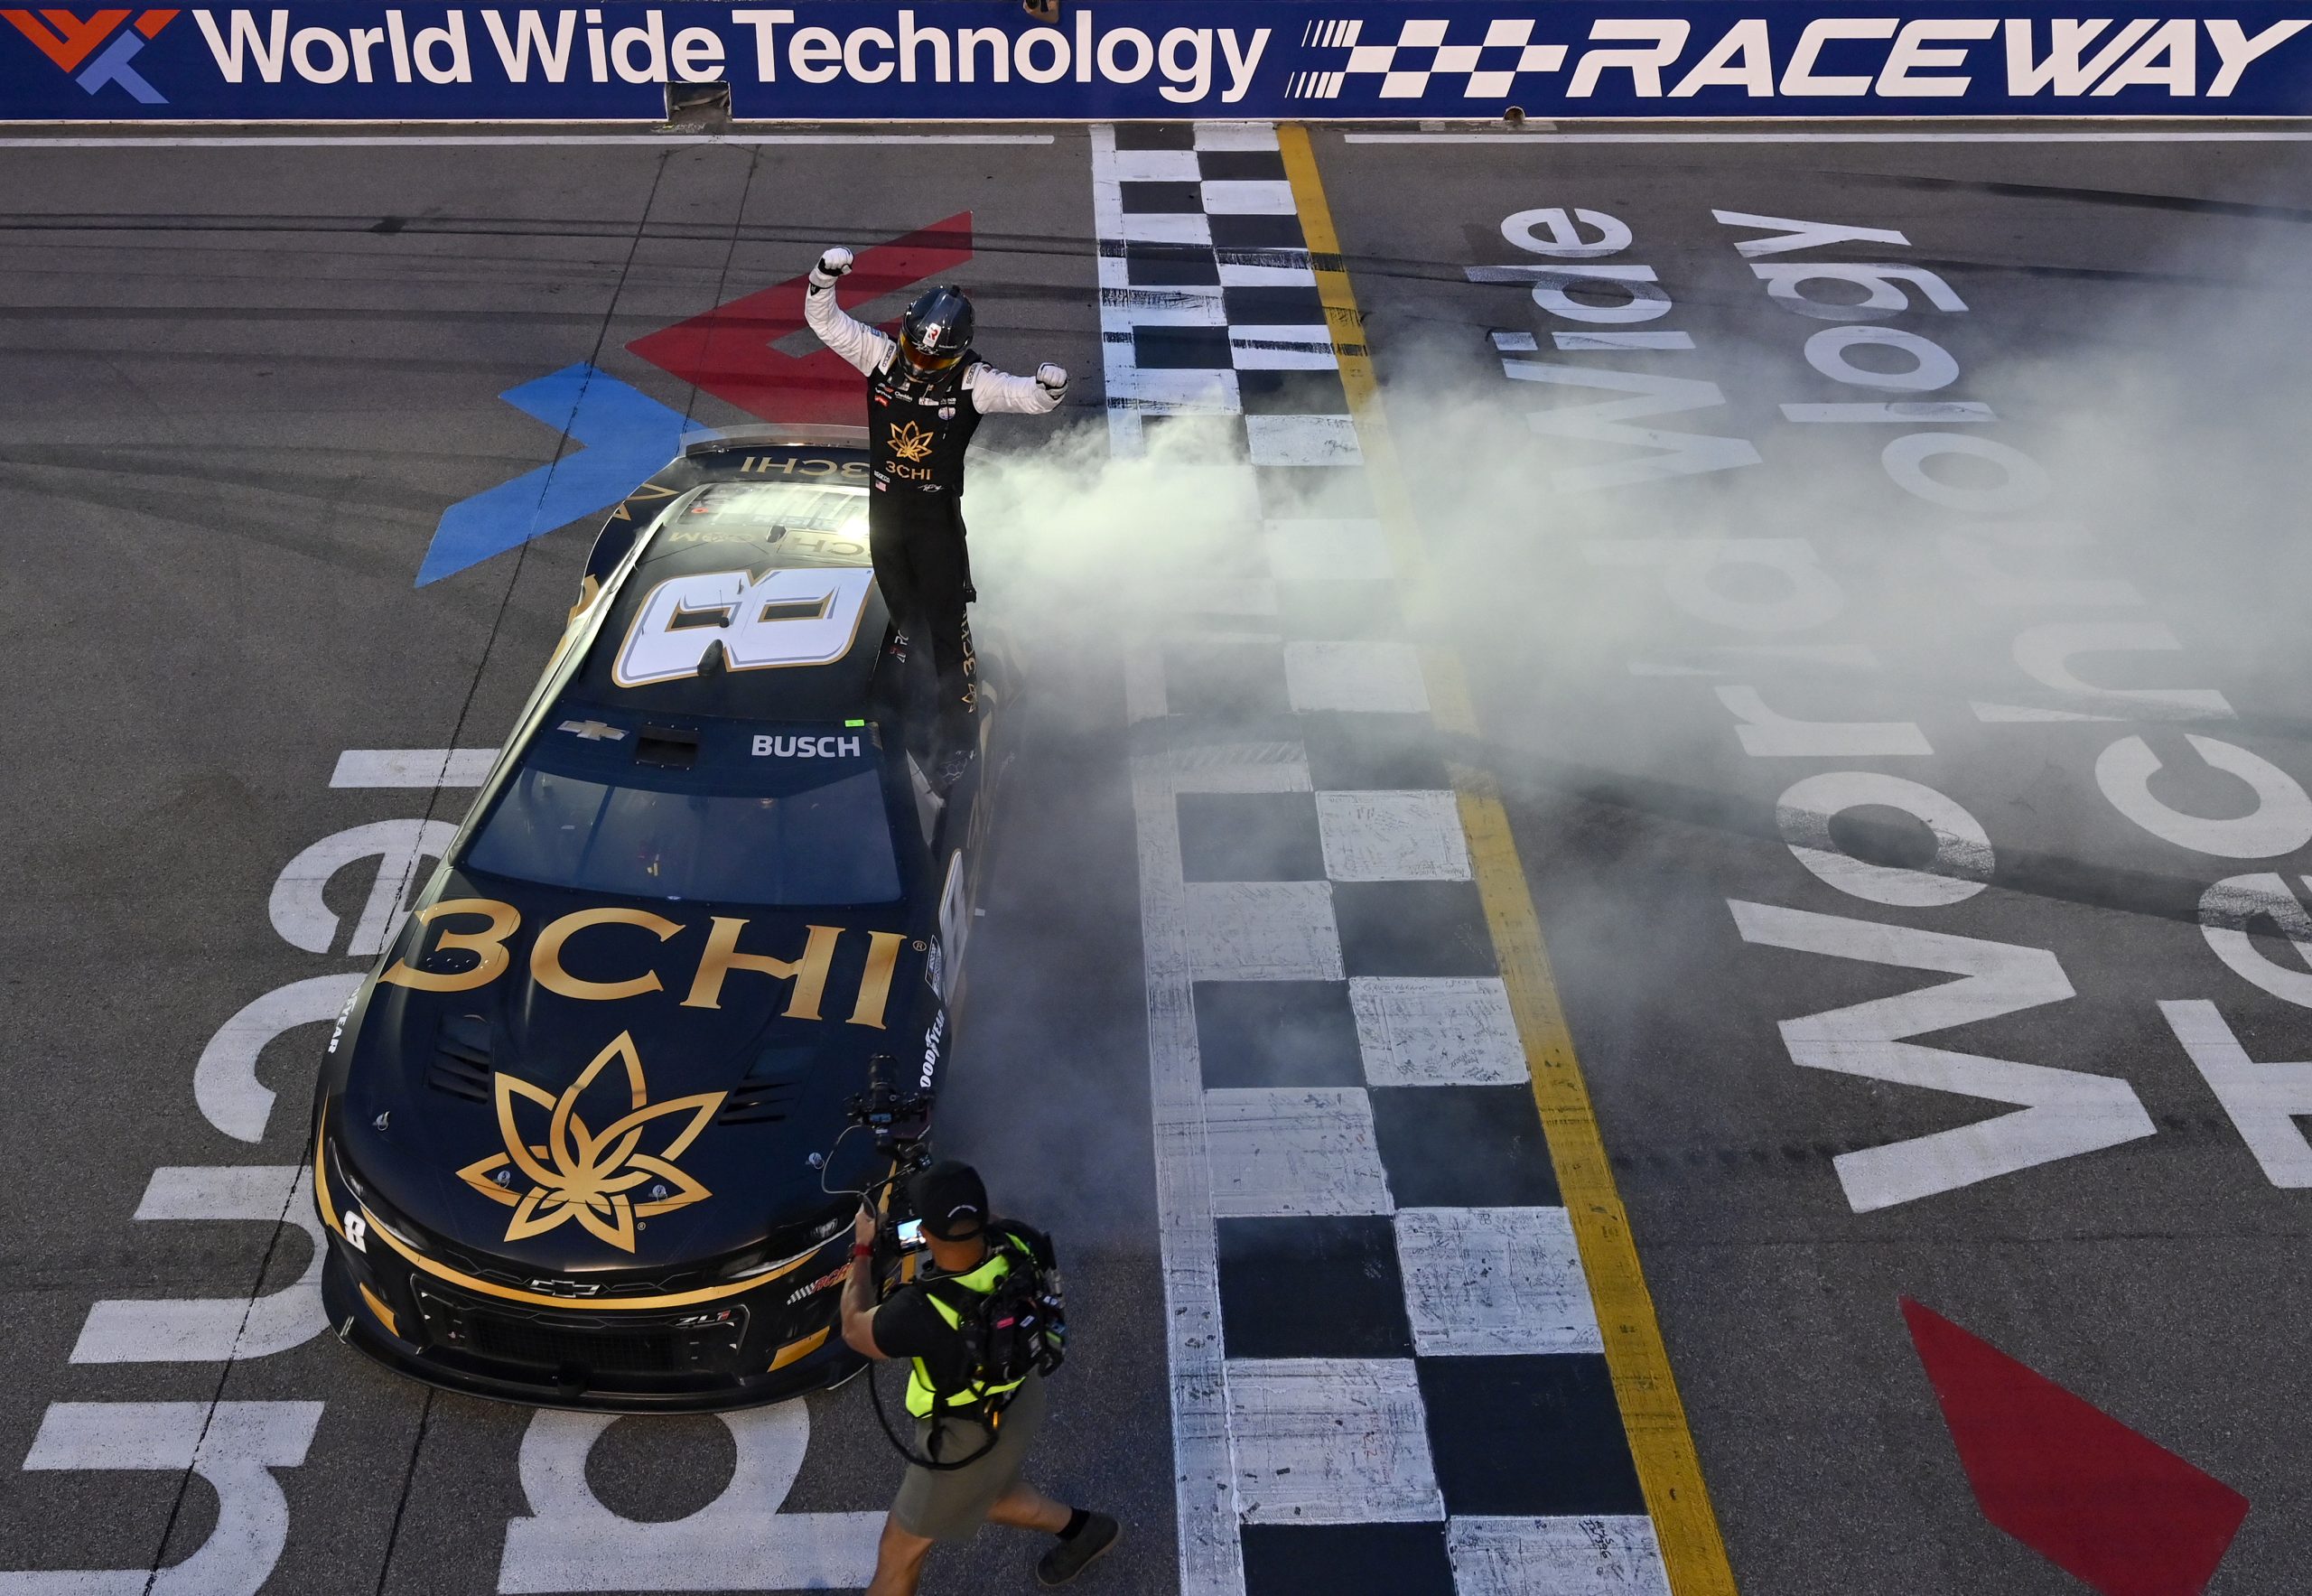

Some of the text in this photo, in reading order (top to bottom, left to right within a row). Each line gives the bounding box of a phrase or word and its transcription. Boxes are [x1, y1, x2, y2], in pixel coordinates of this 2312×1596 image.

[191, 10, 1272, 103] World Wide Technology
[1565, 18, 2312, 98] RACEWAY
[1465, 206, 1763, 495] Wide
[885, 460, 931, 481] 3CHI
[750, 734, 861, 759] BUSCH
[378, 898, 907, 1030] 3CHI
[343, 1209, 368, 1254] 8
